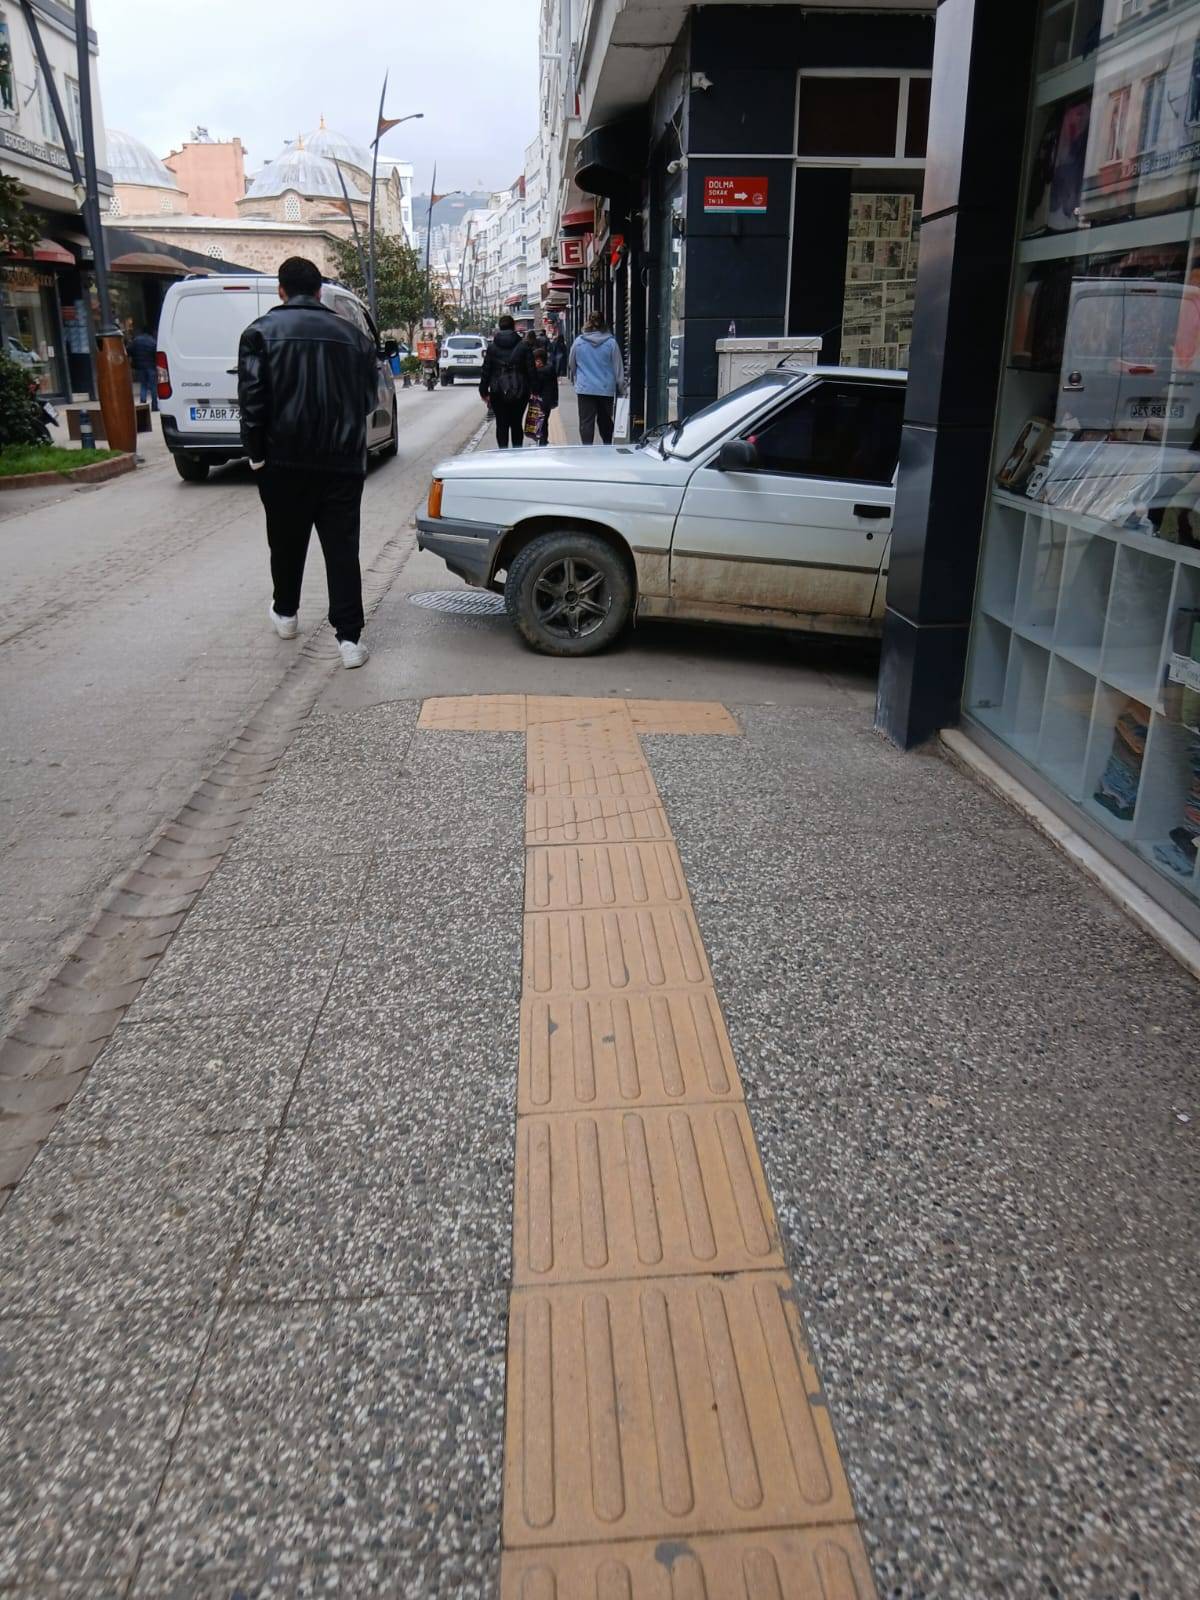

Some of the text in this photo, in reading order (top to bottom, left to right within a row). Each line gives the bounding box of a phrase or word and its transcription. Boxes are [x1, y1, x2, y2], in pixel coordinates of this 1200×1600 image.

[708, 180, 734, 189] DOLMA
[564, 242, 581, 264] E
[196, 408, 207, 419] 57
[210, 408, 227, 419] ABR
